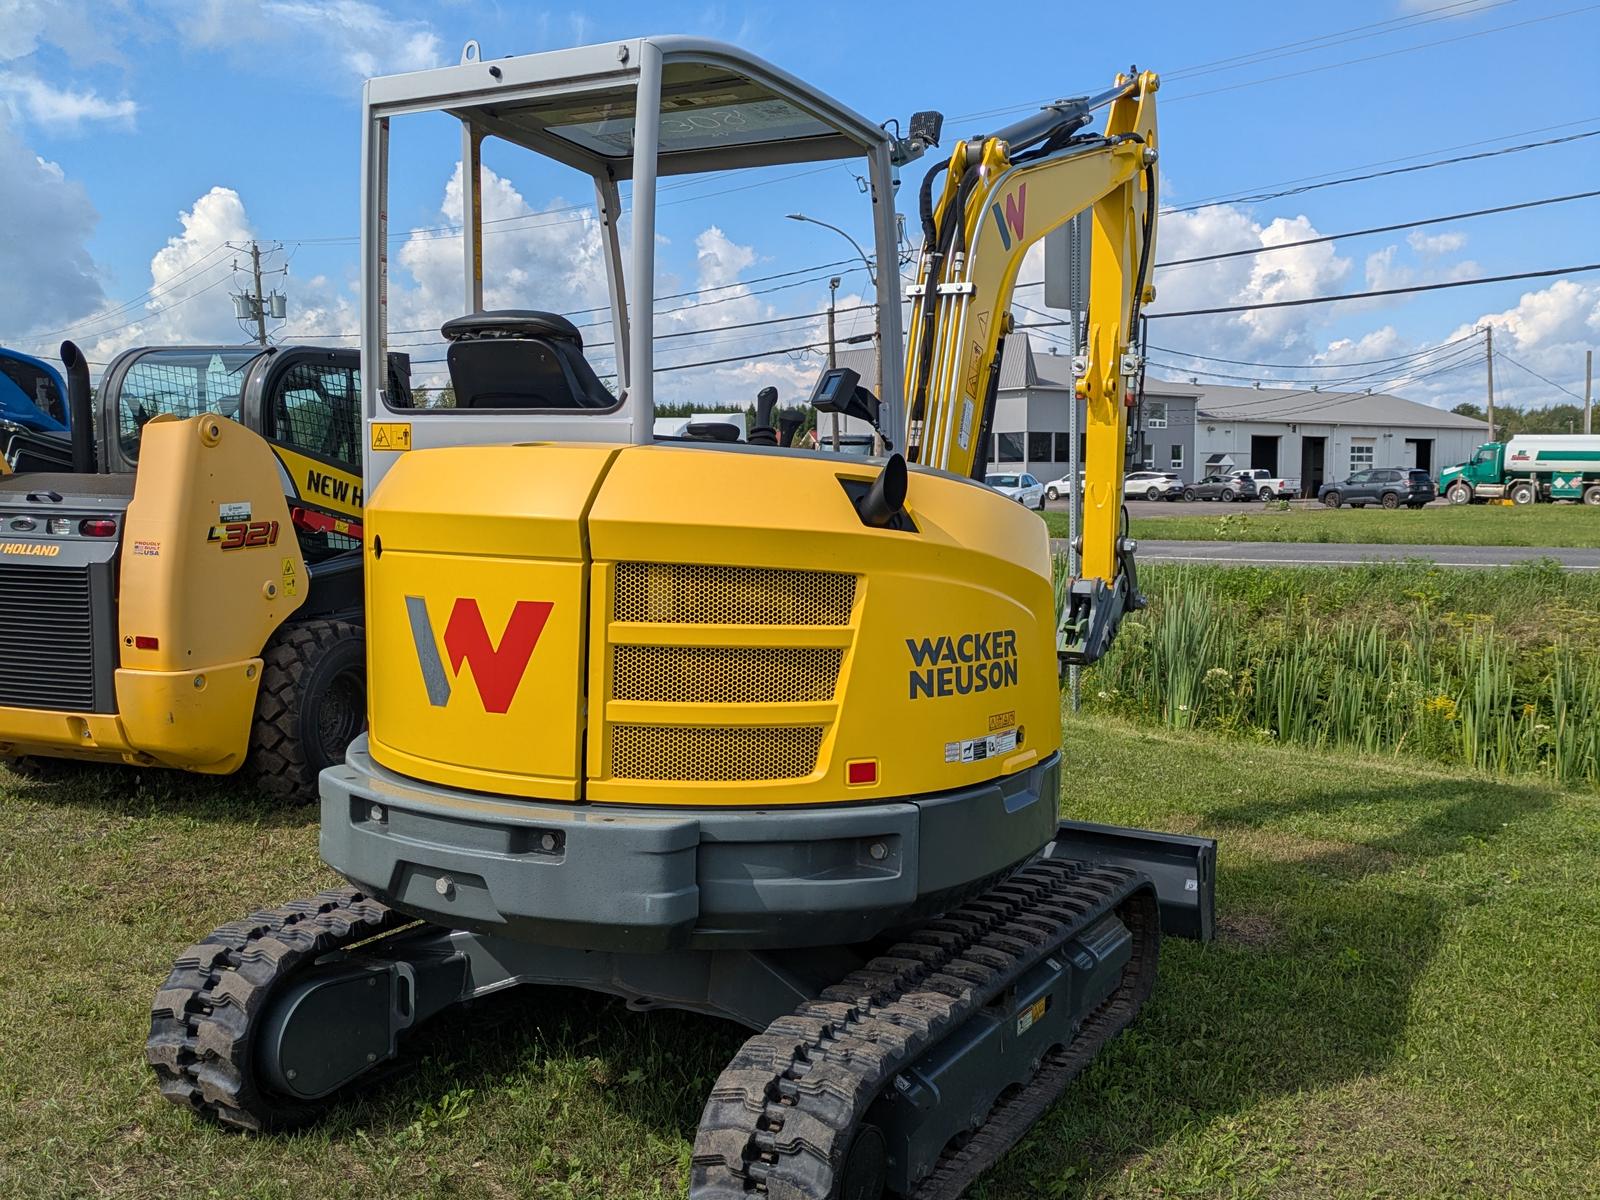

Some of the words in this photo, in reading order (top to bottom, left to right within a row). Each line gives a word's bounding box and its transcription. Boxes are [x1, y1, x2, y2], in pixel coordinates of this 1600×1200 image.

[306, 469, 349, 503] NEW
[3, 543, 60, 557] HOLLAND
[905, 629, 1018, 667] WACKER
[909, 658, 1018, 700] NEUSON
